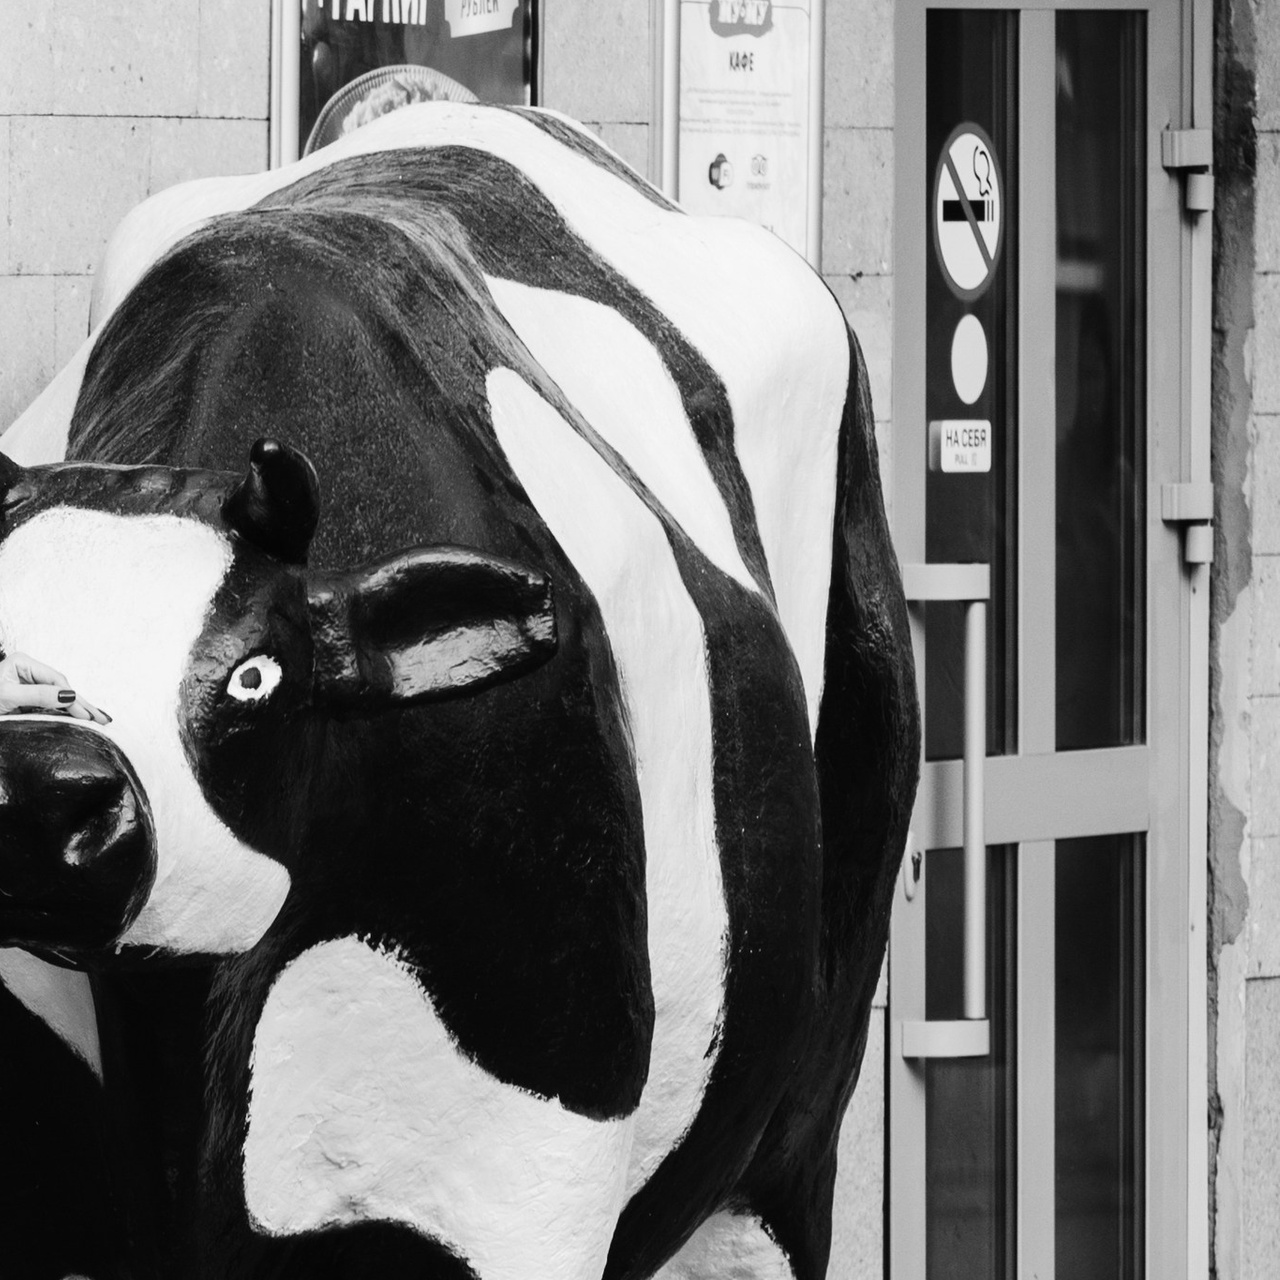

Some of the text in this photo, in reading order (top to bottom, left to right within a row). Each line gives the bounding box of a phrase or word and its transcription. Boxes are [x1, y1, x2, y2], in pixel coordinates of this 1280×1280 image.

[729, 51, 754, 72] КАФЕ
[945, 428, 987, 448] НА СЕБЯ
